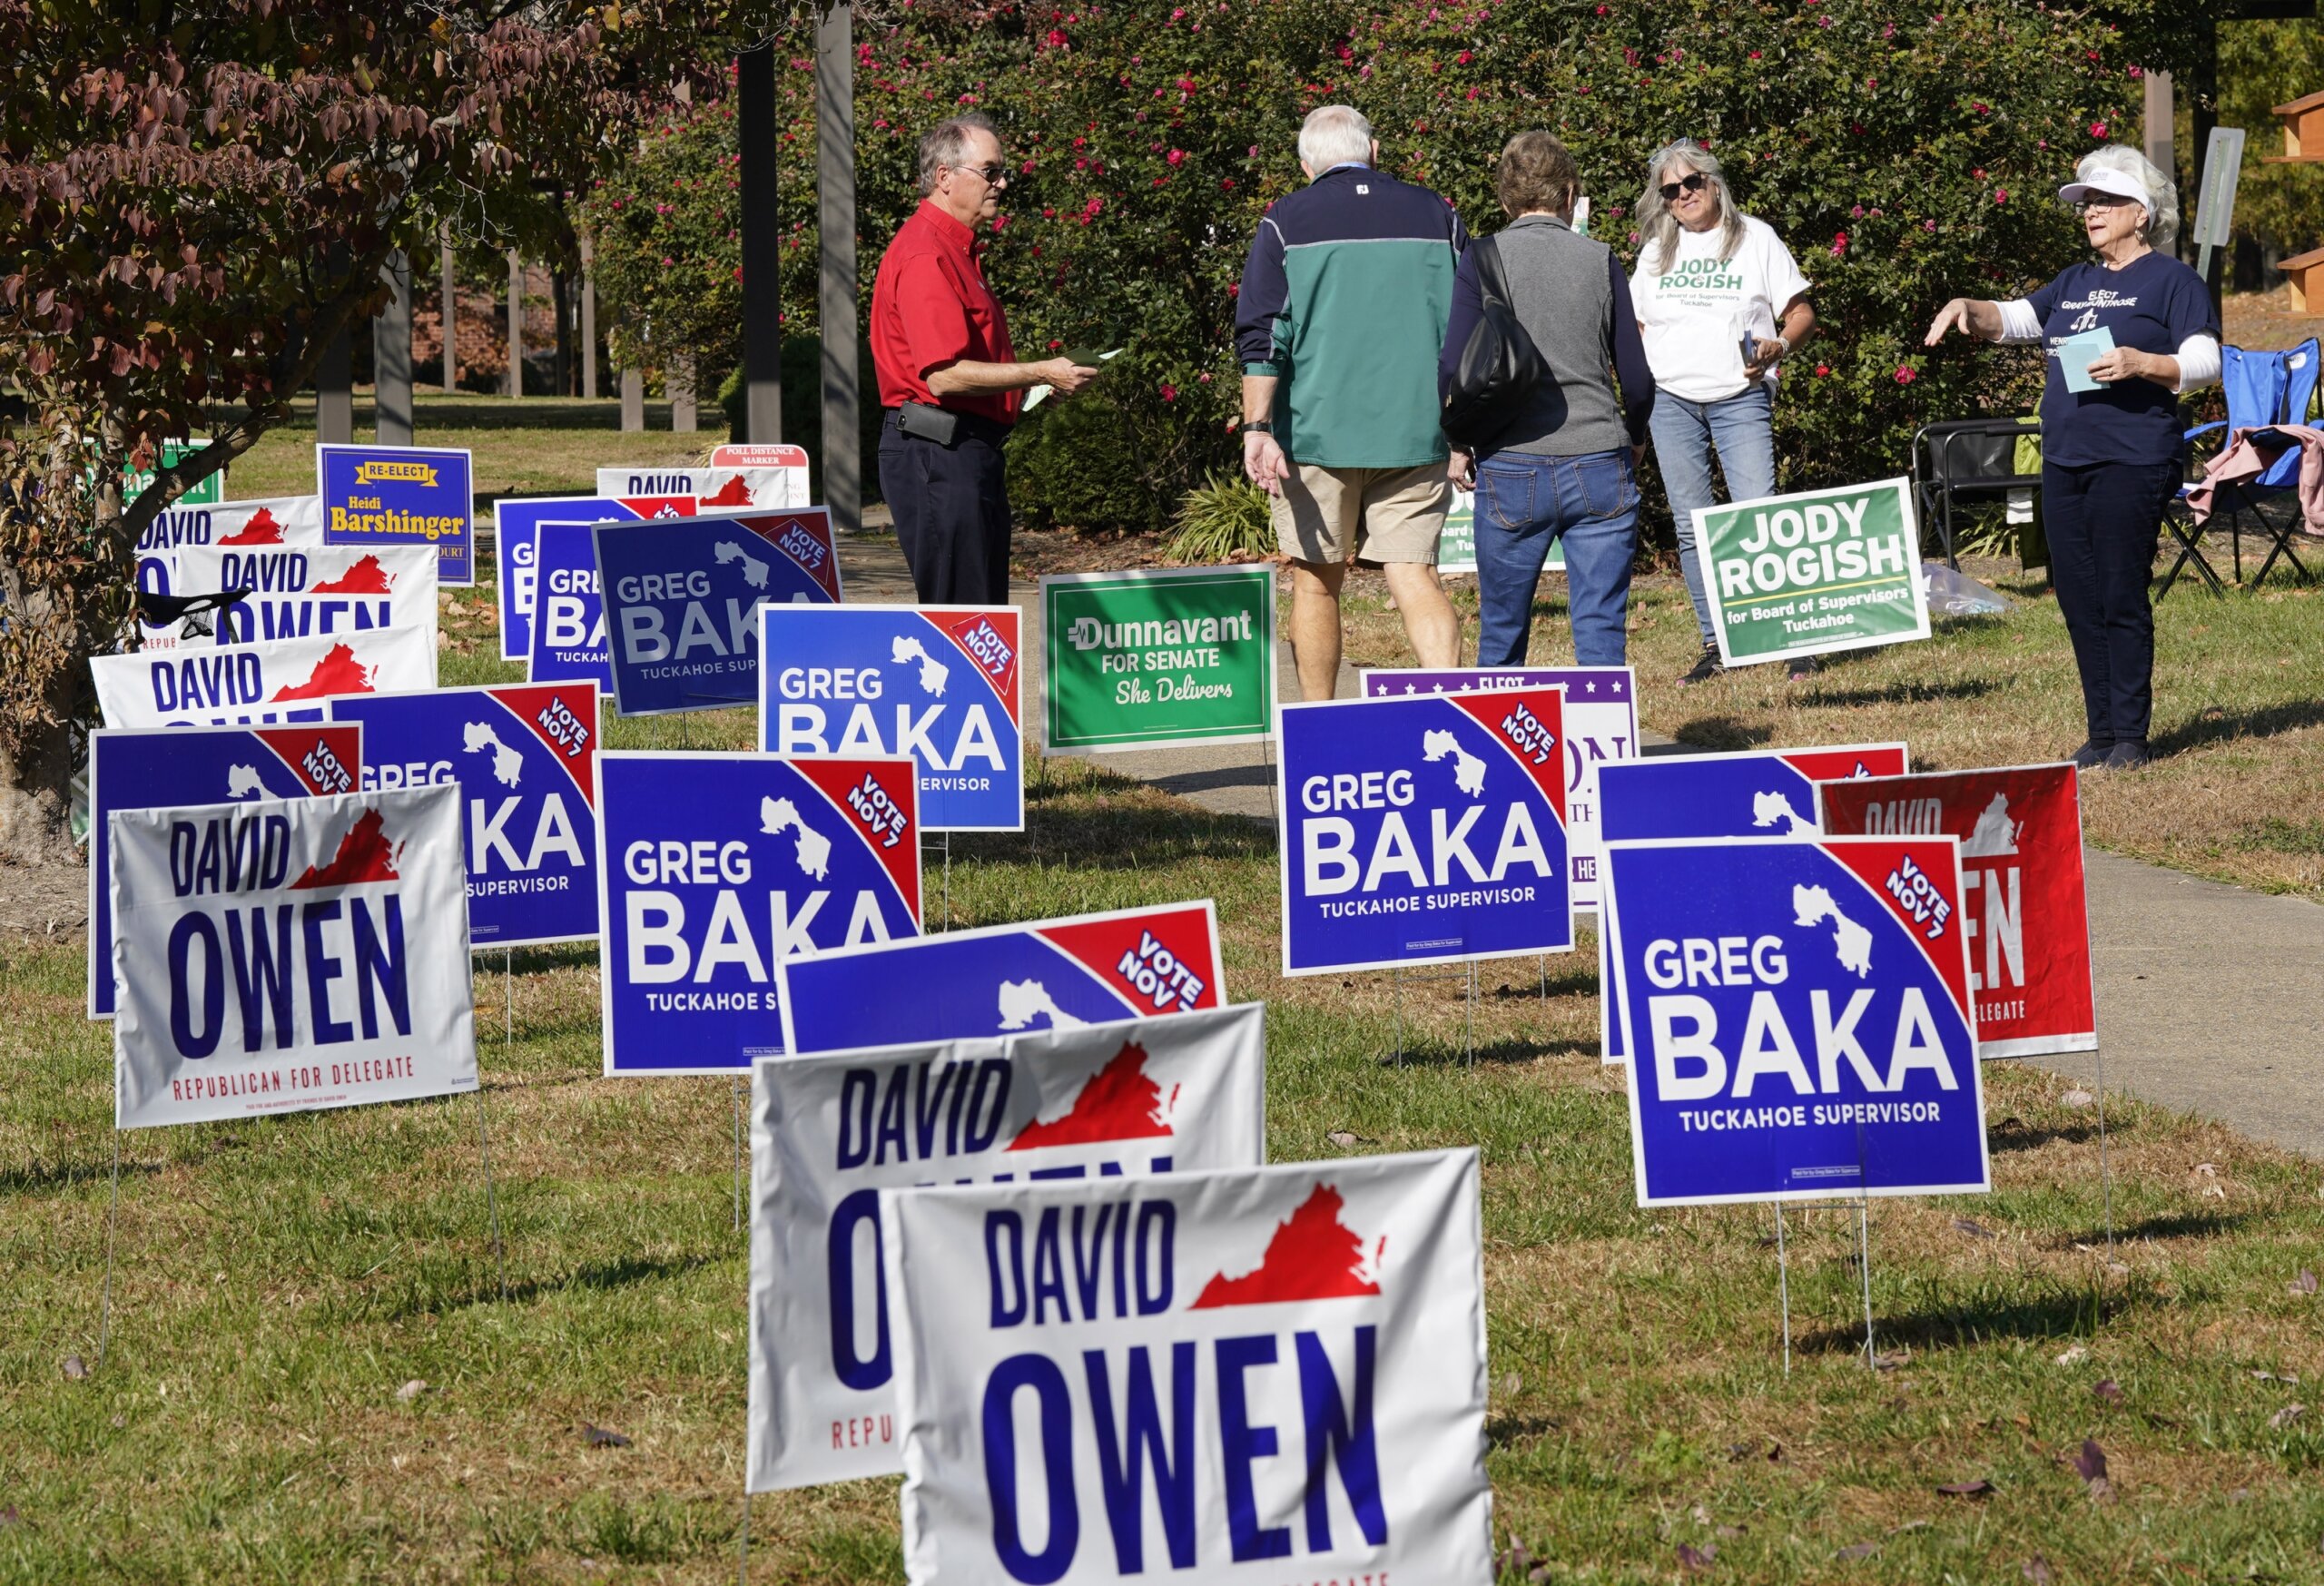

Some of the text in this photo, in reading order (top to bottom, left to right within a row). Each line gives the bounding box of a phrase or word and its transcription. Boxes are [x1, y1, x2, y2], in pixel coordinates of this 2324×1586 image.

[1659, 275, 1742, 290] ROGISH
[1674, 258, 1733, 274] JODY
[2088, 290, 2119, 300] ELECT
[2050, 337, 2068, 345] HENR
[369, 465, 425, 477] RE-ELECT
[742, 457, 780, 465] MARKER
[330, 507, 464, 540] Barshinger
[348, 496, 381, 509] Heidi
[792, 525, 825, 559] VOTE
[1441, 525, 1468, 537] oard
[1738, 497, 1870, 553] JODY
[222, 554, 308, 593] DAVID
[779, 534, 822, 569] NOV 7
[1718, 534, 1905, 598] ROGISH
[617, 570, 711, 603] GREG
[1727, 588, 1909, 625] for Board of Supervisors
[620, 592, 811, 665] BAK
[978, 620, 1012, 665] VOTE
[1068, 610, 1252, 651] Dunnavant
[1783, 613, 1854, 634] Tuckahoe
[556, 652, 608, 663] TUCKAH
[641, 663, 724, 679] TUCKAHOE
[964, 630, 1005, 675] NOV 7
[1102, 648, 1220, 674] FOR SENATE
[151, 652, 263, 713] DAVID
[779, 667, 882, 699] GREG
[1116, 674, 1233, 705] She Delivers
[537, 708, 583, 757] NOV 7
[550, 697, 589, 744] VOTE
[779, 703, 1007, 771] BAKA
[1502, 714, 1549, 765] NOV 7
[1515, 703, 1555, 751] VOTE
[302, 752, 335, 793] NOV
[316, 740, 352, 792] VOTE
[363, 760, 455, 792] GREG
[919, 778, 990, 791] ERVISOR
[863, 773, 908, 833] VOTE
[1302, 769, 1414, 813] GREG
[470, 793, 586, 875] KA
[847, 788, 900, 849] NOV 7
[170, 815, 290, 897] DAVID
[625, 841, 752, 885] GREG
[1303, 801, 1553, 897] BAKA
[466, 876, 569, 897] SUPERVISOR
[1320, 886, 1536, 919] TUCKAHOE SUPERVISOR
[1886, 872, 1944, 940] NOV 7
[1902, 856, 1950, 923] VOTE
[625, 890, 891, 984] BAKA
[1962, 867, 2024, 991] EN
[167, 893, 412, 1060] OWEN
[1118, 951, 1176, 1008] NOV
[1139, 931, 1204, 1004] VOTE
[1644, 934, 1788, 990] GREG
[646, 992, 759, 1011] TUCKAHOE
[1974, 1000, 2025, 1022] ELEGATE
[1649, 987, 1960, 1102] BAKA
[172, 1056, 414, 1100] REPUBLICAN FOR DELEGATE
[837, 1059, 1012, 1170] DAVID
[1679, 1101, 1941, 1132] TUCKAHOE SUPERVISOR
[983, 1199, 1177, 1329] DAVID
[982, 1325, 1388, 1586] OWEN
